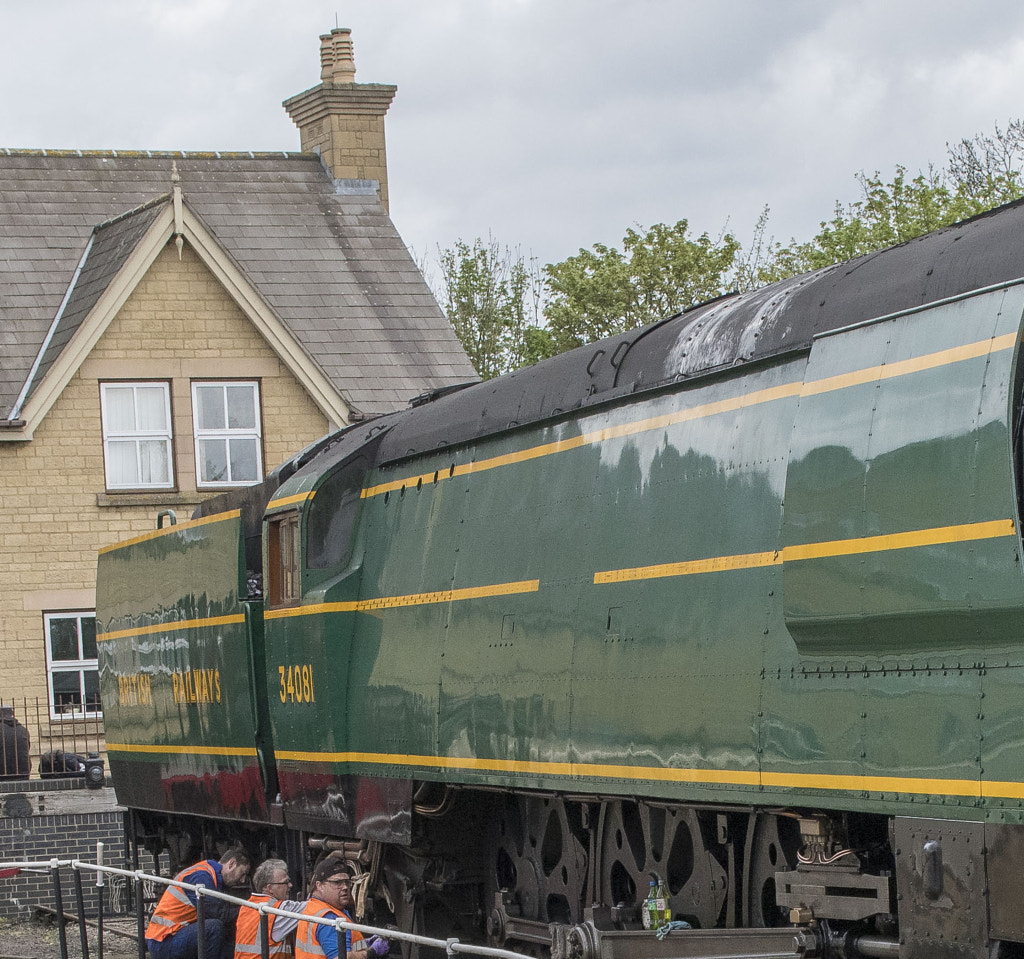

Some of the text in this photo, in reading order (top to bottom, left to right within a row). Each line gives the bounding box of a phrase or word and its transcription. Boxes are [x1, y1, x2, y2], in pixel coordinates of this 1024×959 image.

[118, 668, 221, 707] BRITISH RAILWAYS
[278, 664, 315, 704] 34081
